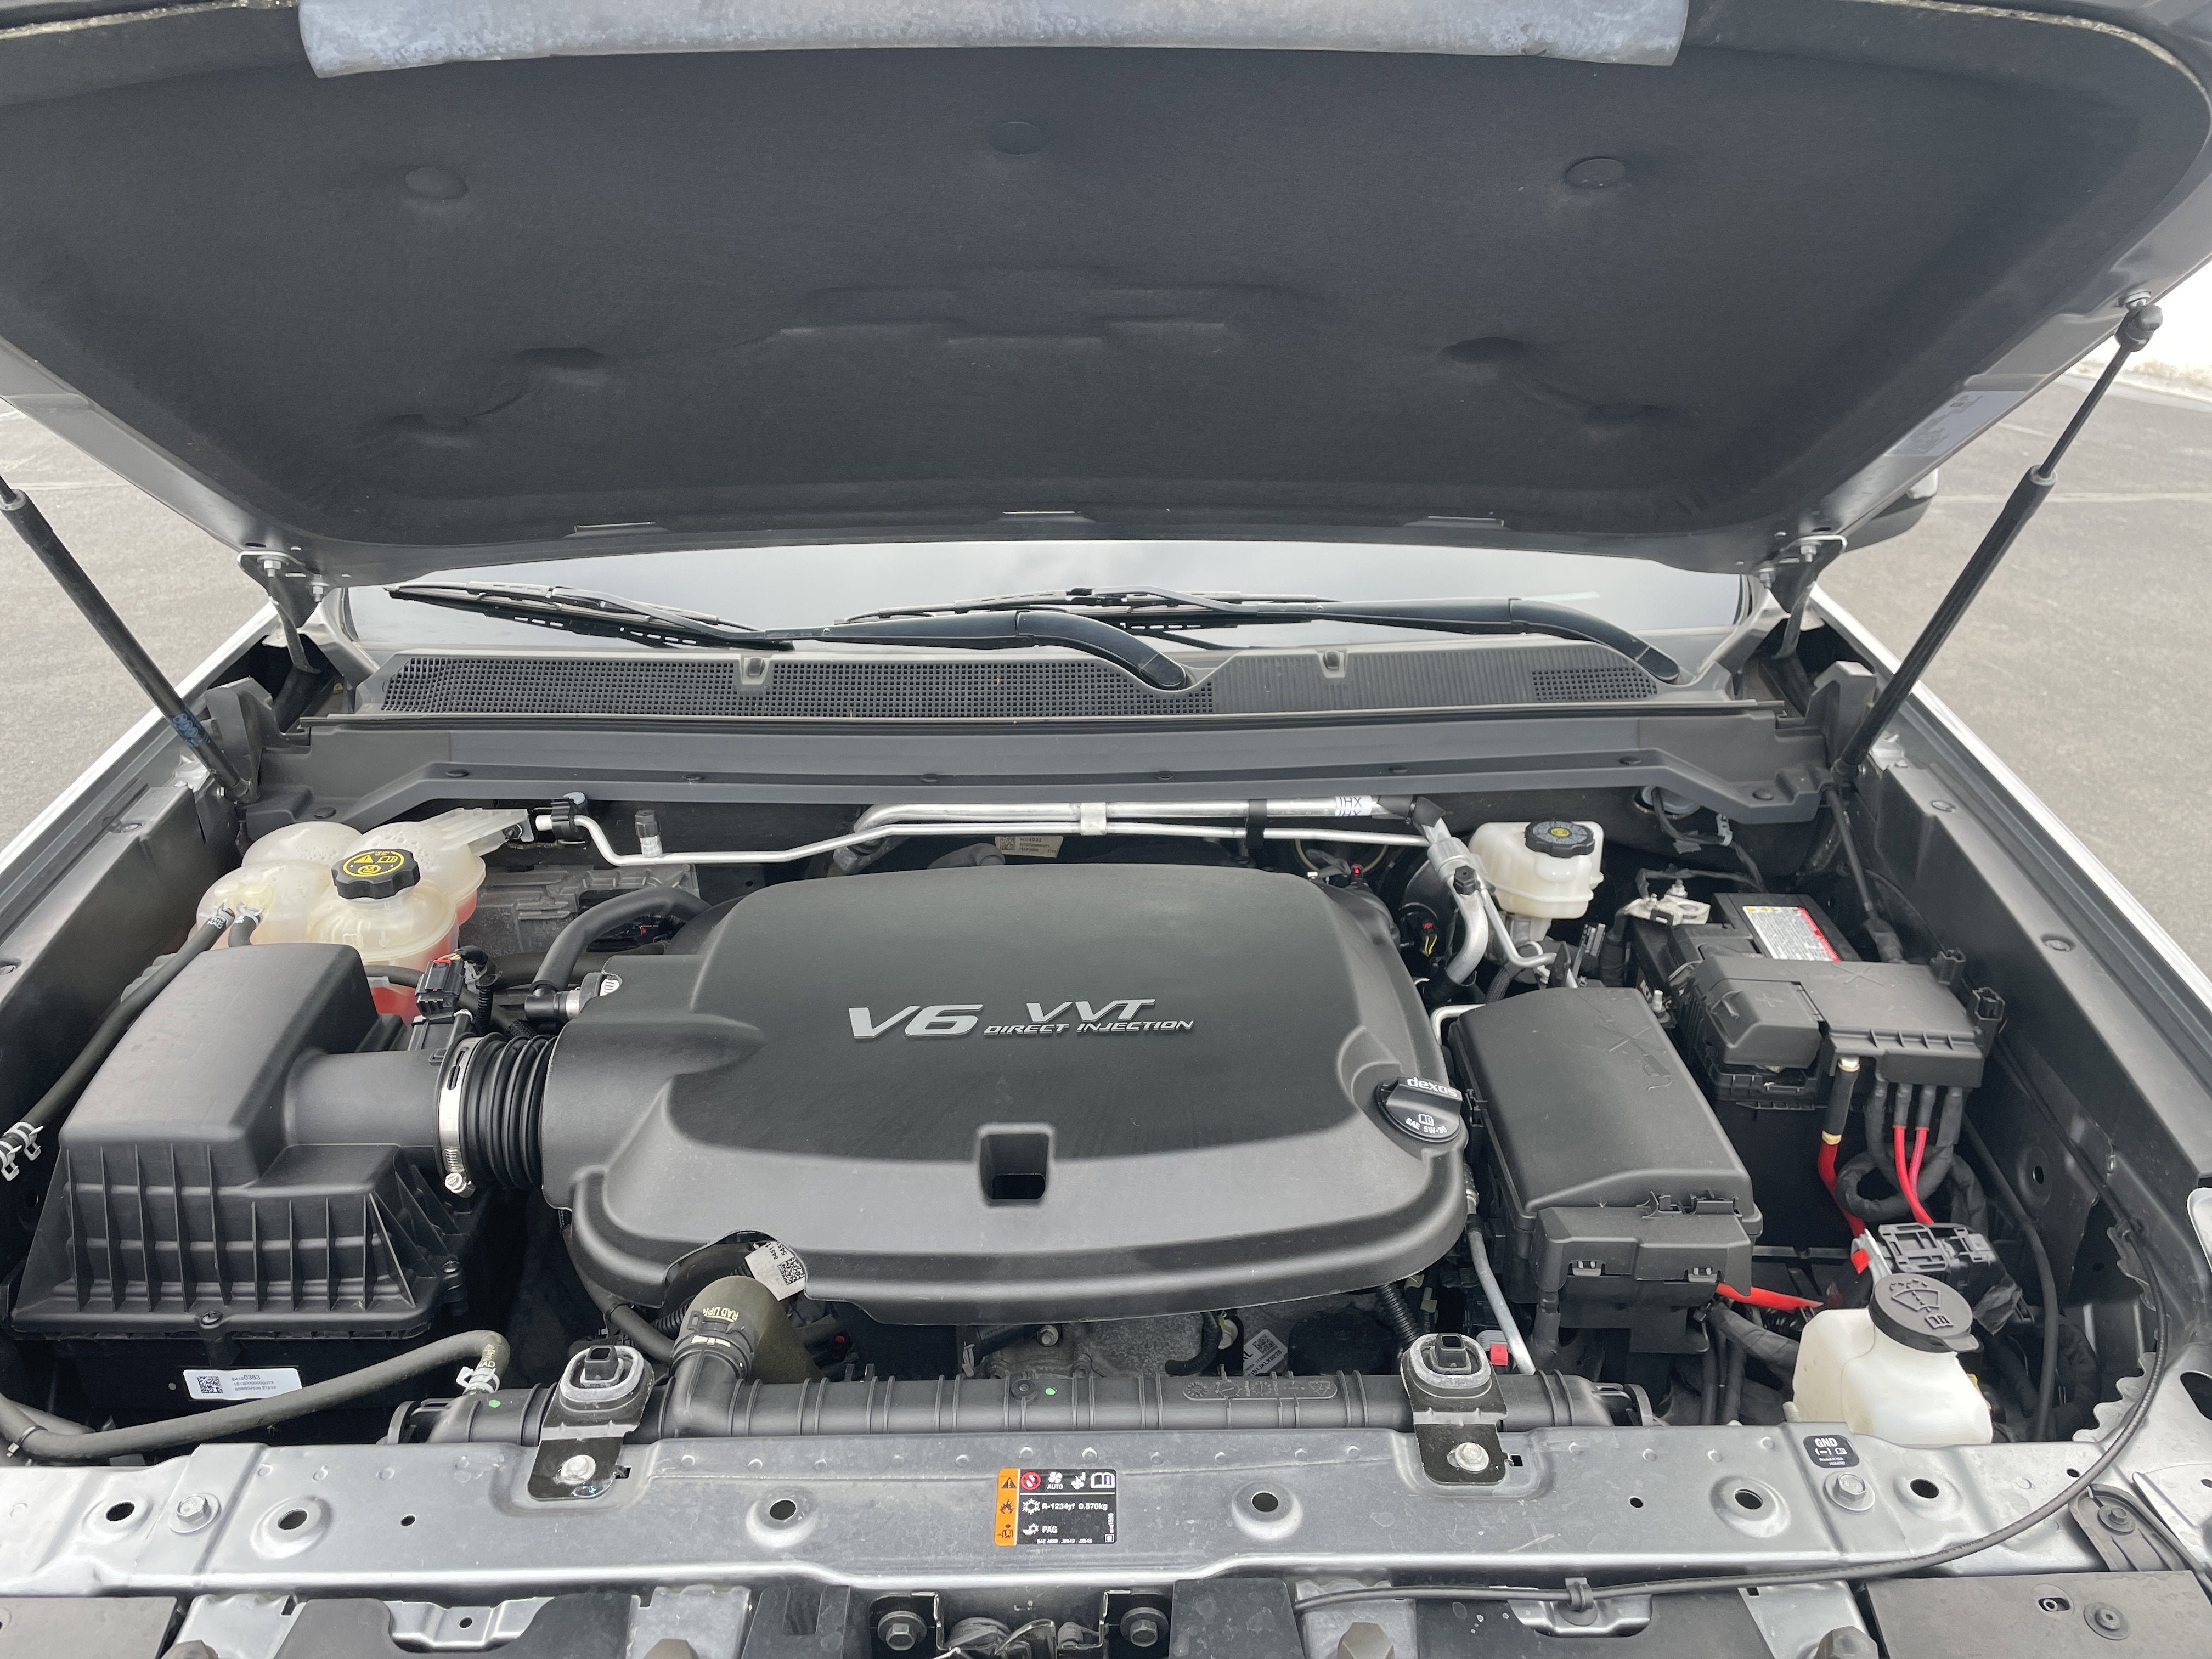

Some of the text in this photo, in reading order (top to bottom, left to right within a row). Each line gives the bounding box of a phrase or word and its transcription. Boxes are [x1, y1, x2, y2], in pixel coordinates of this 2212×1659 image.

[848, 998, 1155, 1039] V6 VVT
[983, 1020, 1194, 1035] DIRECT INJECTION
[1407, 1077, 1458, 1097] dexos
[1405, 1118, 1448, 1134] SAE 5W-30
[703, 1306, 739, 1321] RAD UPR
[1814, 1437, 1838, 1447] GND
[1042, 1503, 1075, 1511] R-1234yf
